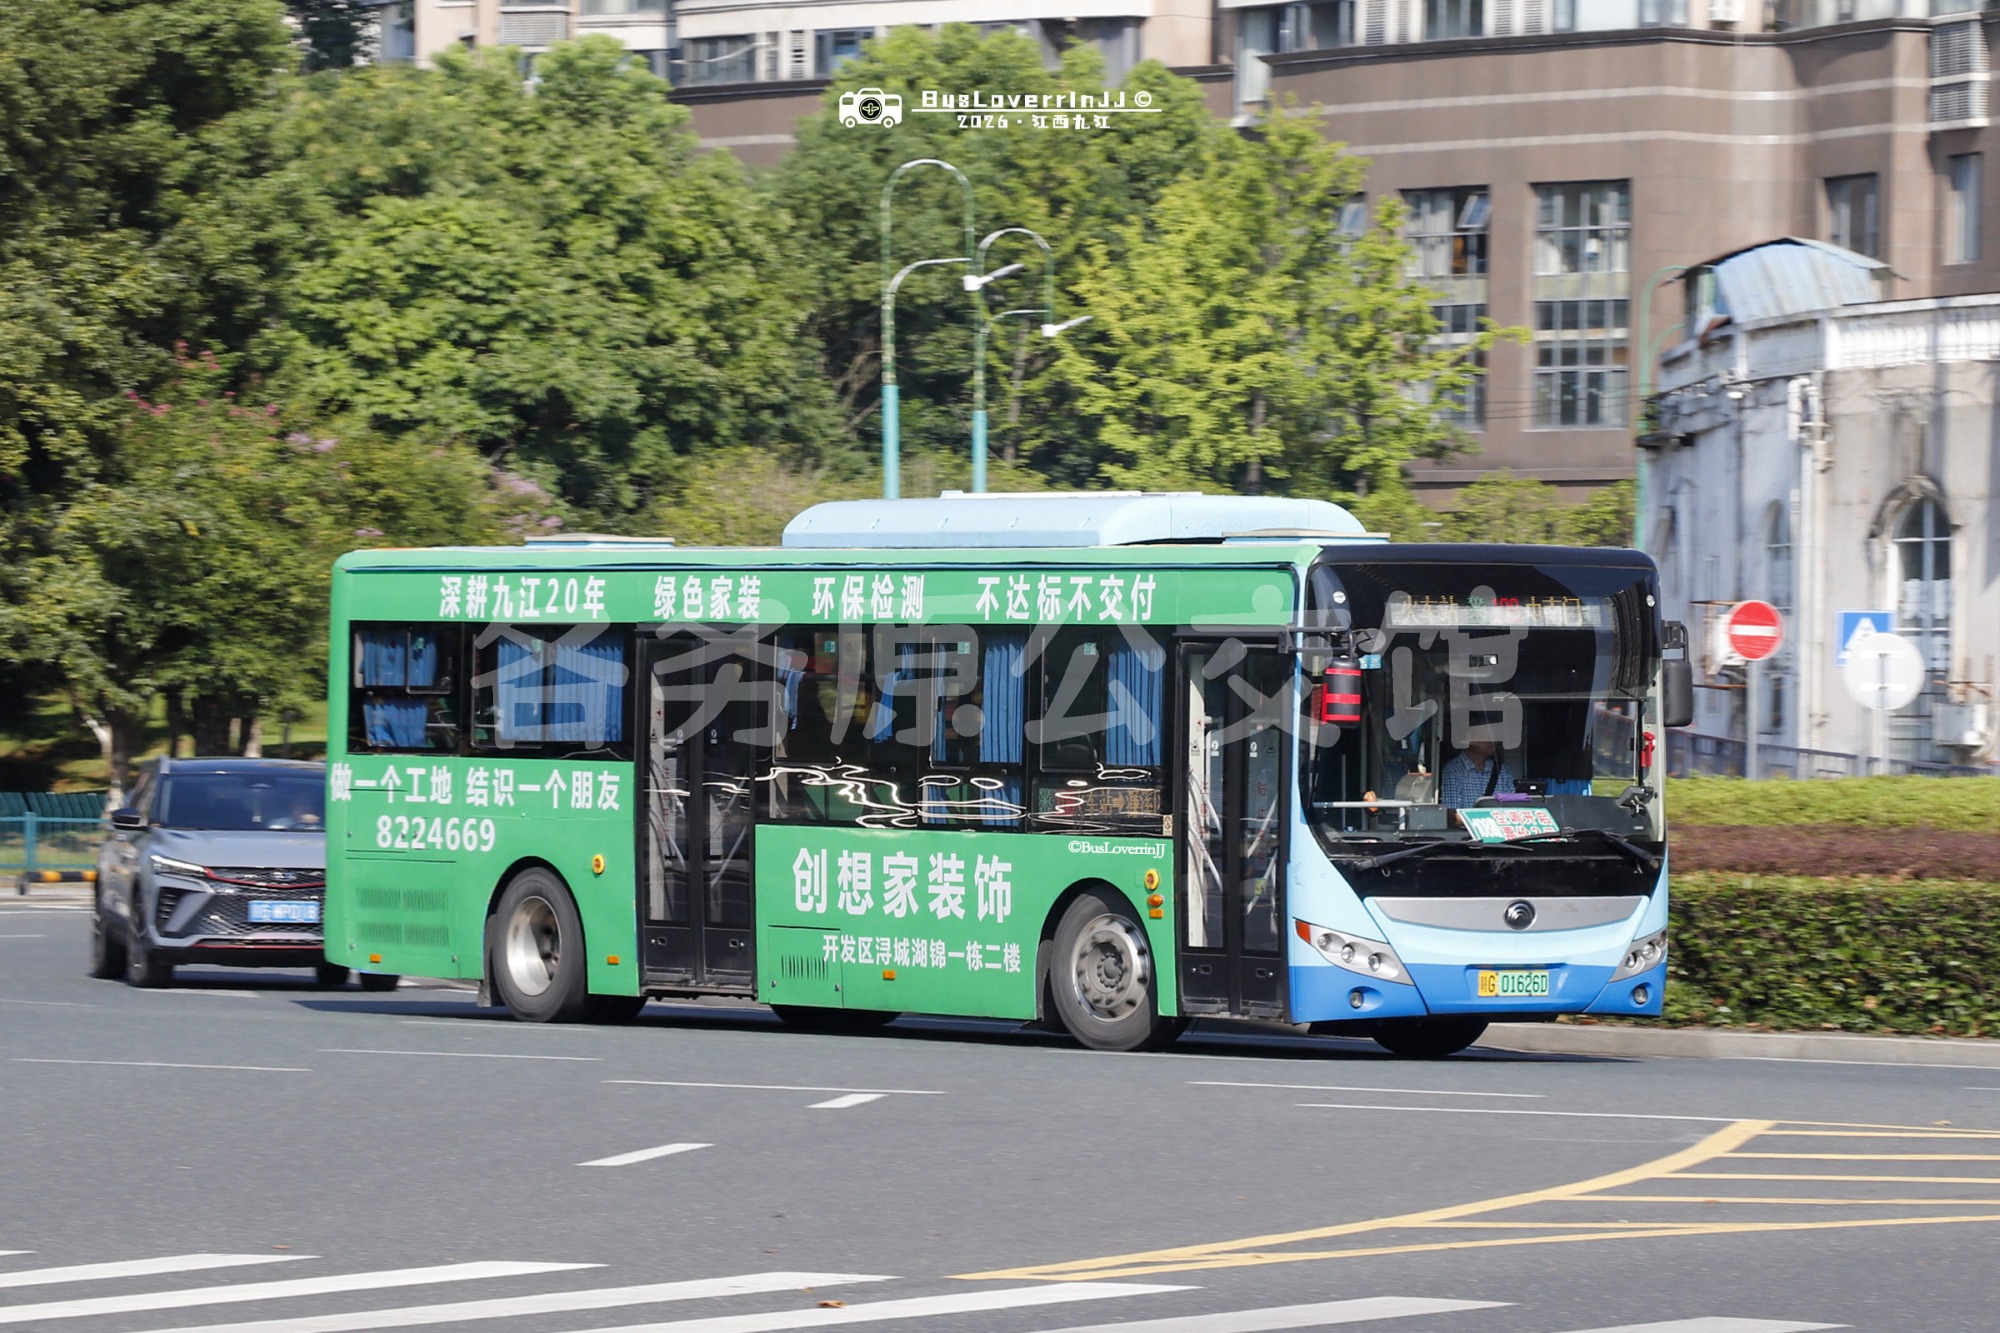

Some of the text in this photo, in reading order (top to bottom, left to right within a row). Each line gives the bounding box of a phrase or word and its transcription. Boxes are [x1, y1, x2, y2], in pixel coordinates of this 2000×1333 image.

[439, 573, 1156, 622] 深耕九江20年 绿色家装 环保检测 不达标不交付
[331, 762, 452, 804] 做一个工地
[466, 768, 621, 811] 结识一个朋友
[377, 814, 495, 852] 8224669
[792, 847, 1013, 924] 创想家装饰
[822, 934, 1021, 974] 开发区浔城湖锦一栋二楼
